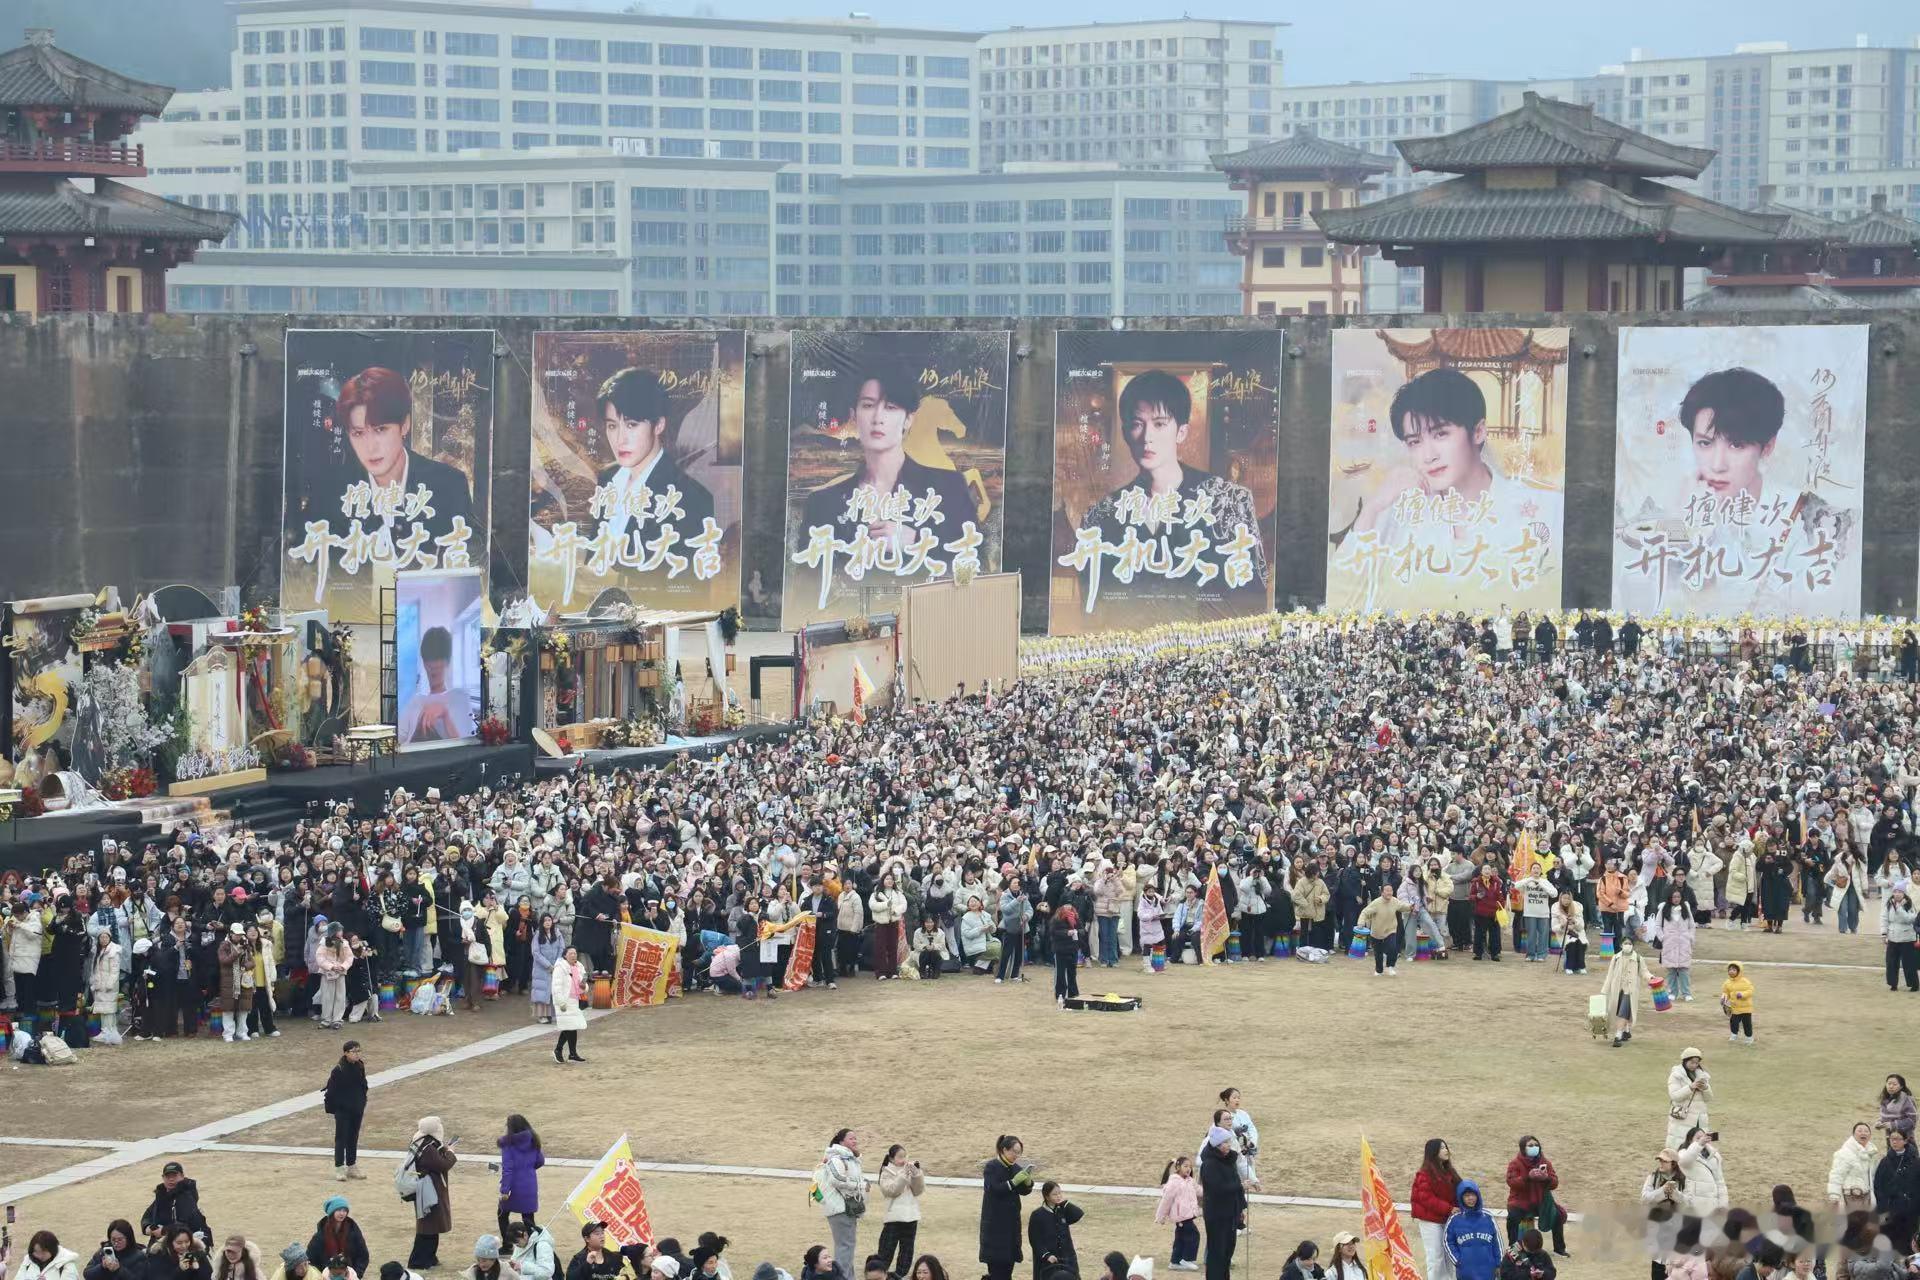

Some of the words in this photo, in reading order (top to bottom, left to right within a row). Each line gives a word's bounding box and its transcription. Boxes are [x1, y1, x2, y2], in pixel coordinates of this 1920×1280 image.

[341, 480, 436, 526] 檀健次
[588, 482, 687, 529] 檀健次
[846, 484, 945, 528] 檀健次
[1114, 486, 1217, 535] 檀健次
[1392, 487, 1498, 528] 檀健次
[1684, 490, 1790, 534] 檀健次
[289, 515, 472, 604] 开机大吉
[543, 517, 724, 606] 开机大吉
[792, 521, 984, 609] 开机大吉
[1058, 523, 1256, 613] 开机大吉
[1336, 528, 1540, 615] 开机大吉
[1625, 531, 1835, 609] 开机大吉
